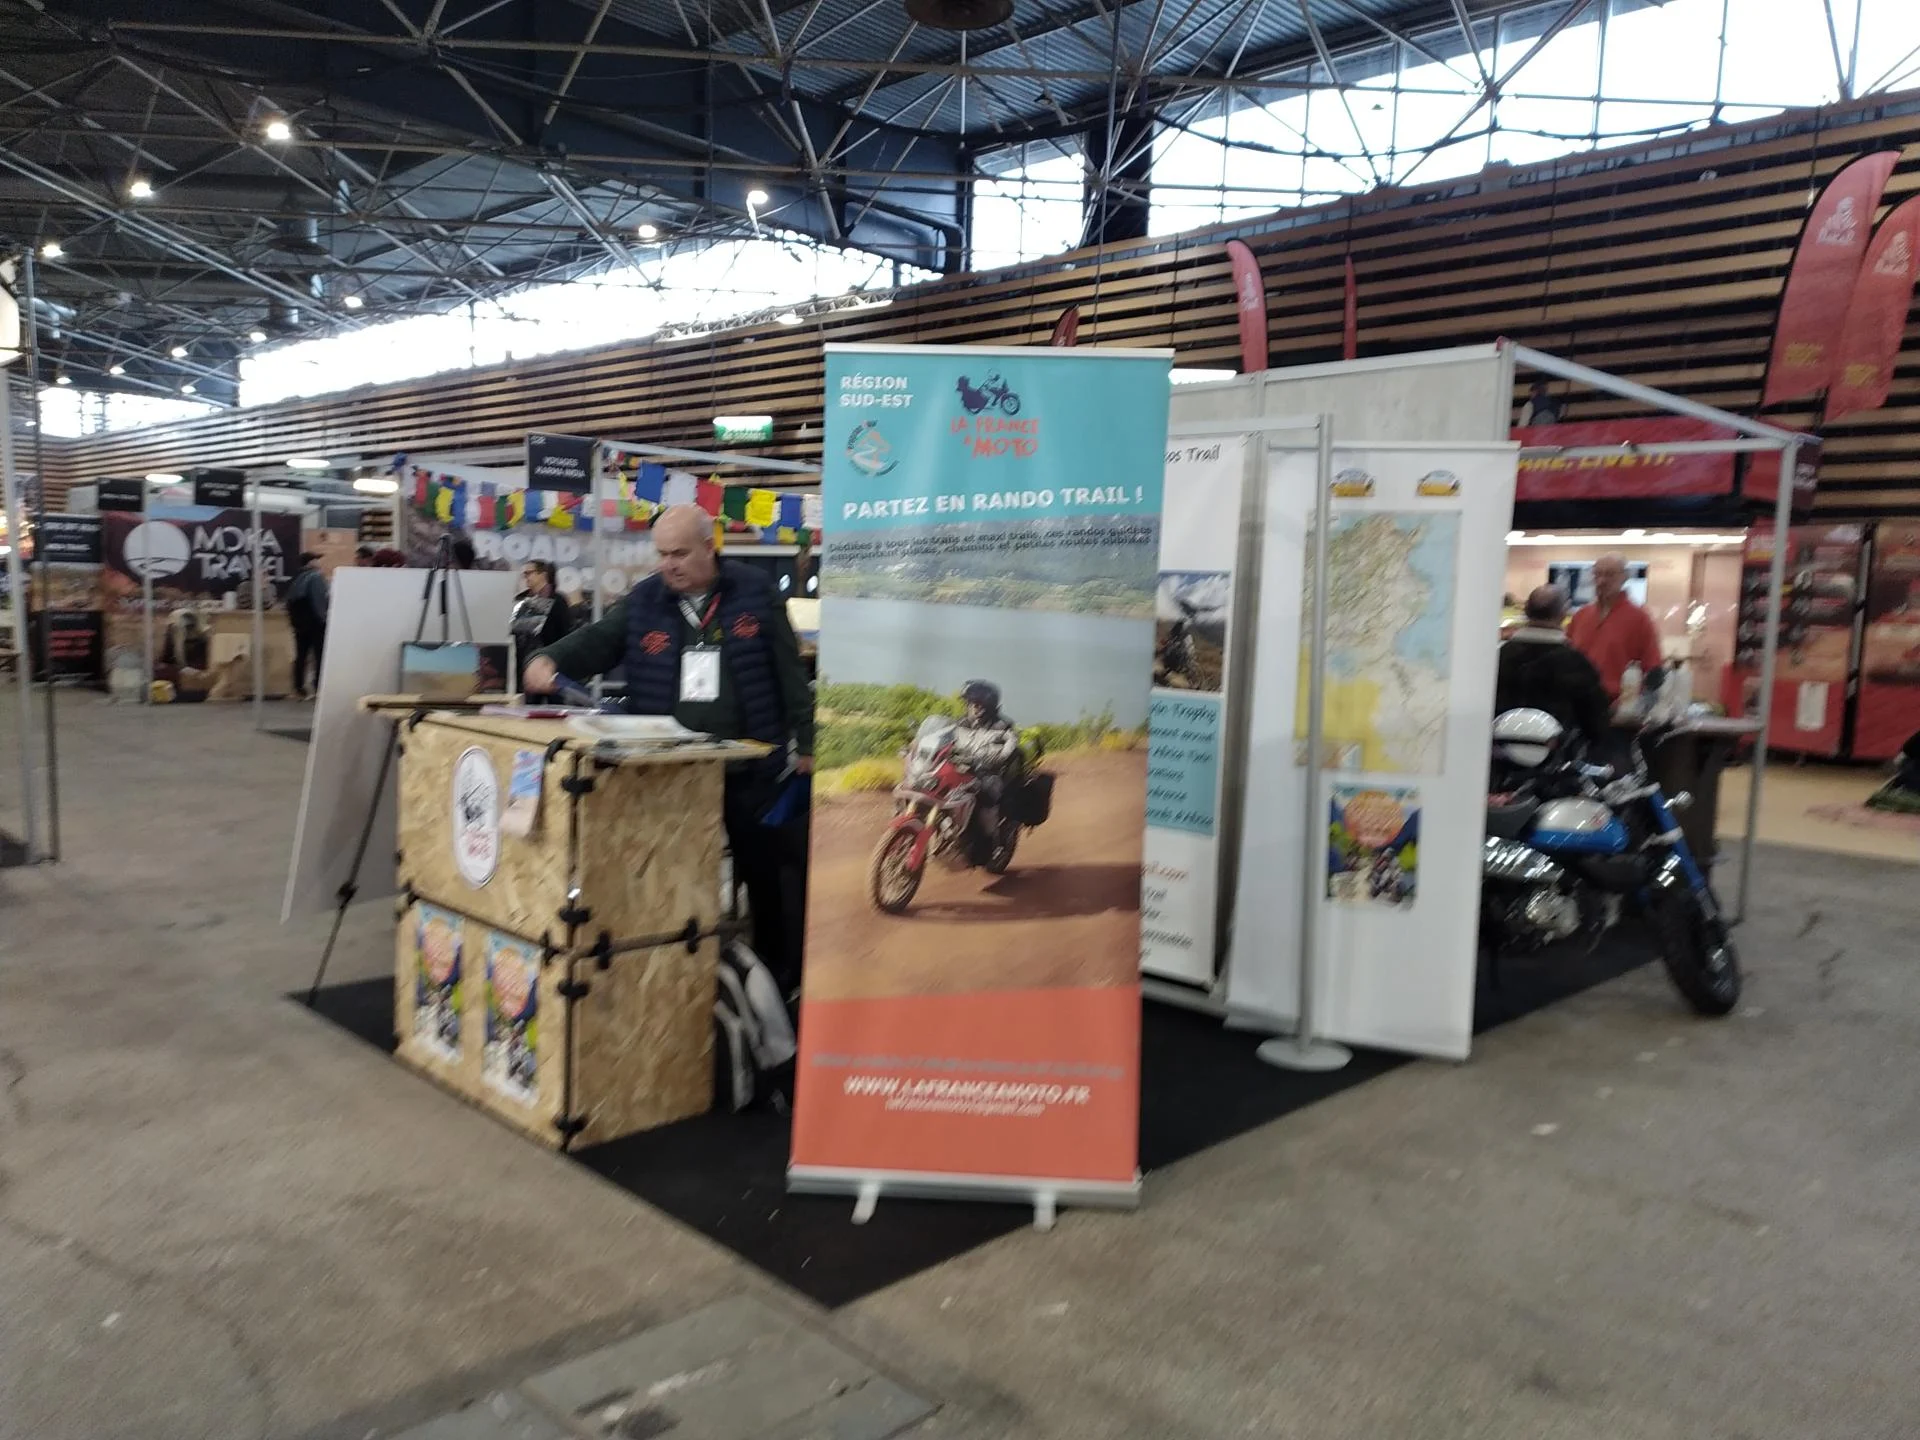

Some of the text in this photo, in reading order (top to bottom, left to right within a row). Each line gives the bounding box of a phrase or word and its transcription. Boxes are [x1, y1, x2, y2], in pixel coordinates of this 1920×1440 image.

[840, 372, 908, 391] RÉGION
[839, 393, 914, 409] SUD-EST
[950, 415, 1040, 435] LA FRANCE
[972, 436, 1039, 459] MOTO
[1186, 443, 1221, 462] Trail
[843, 485, 1144, 520] PARTEZ EN RANDO TRAIL !
[193, 525, 283, 554] MOKA
[471, 531, 581, 562] ROAD
